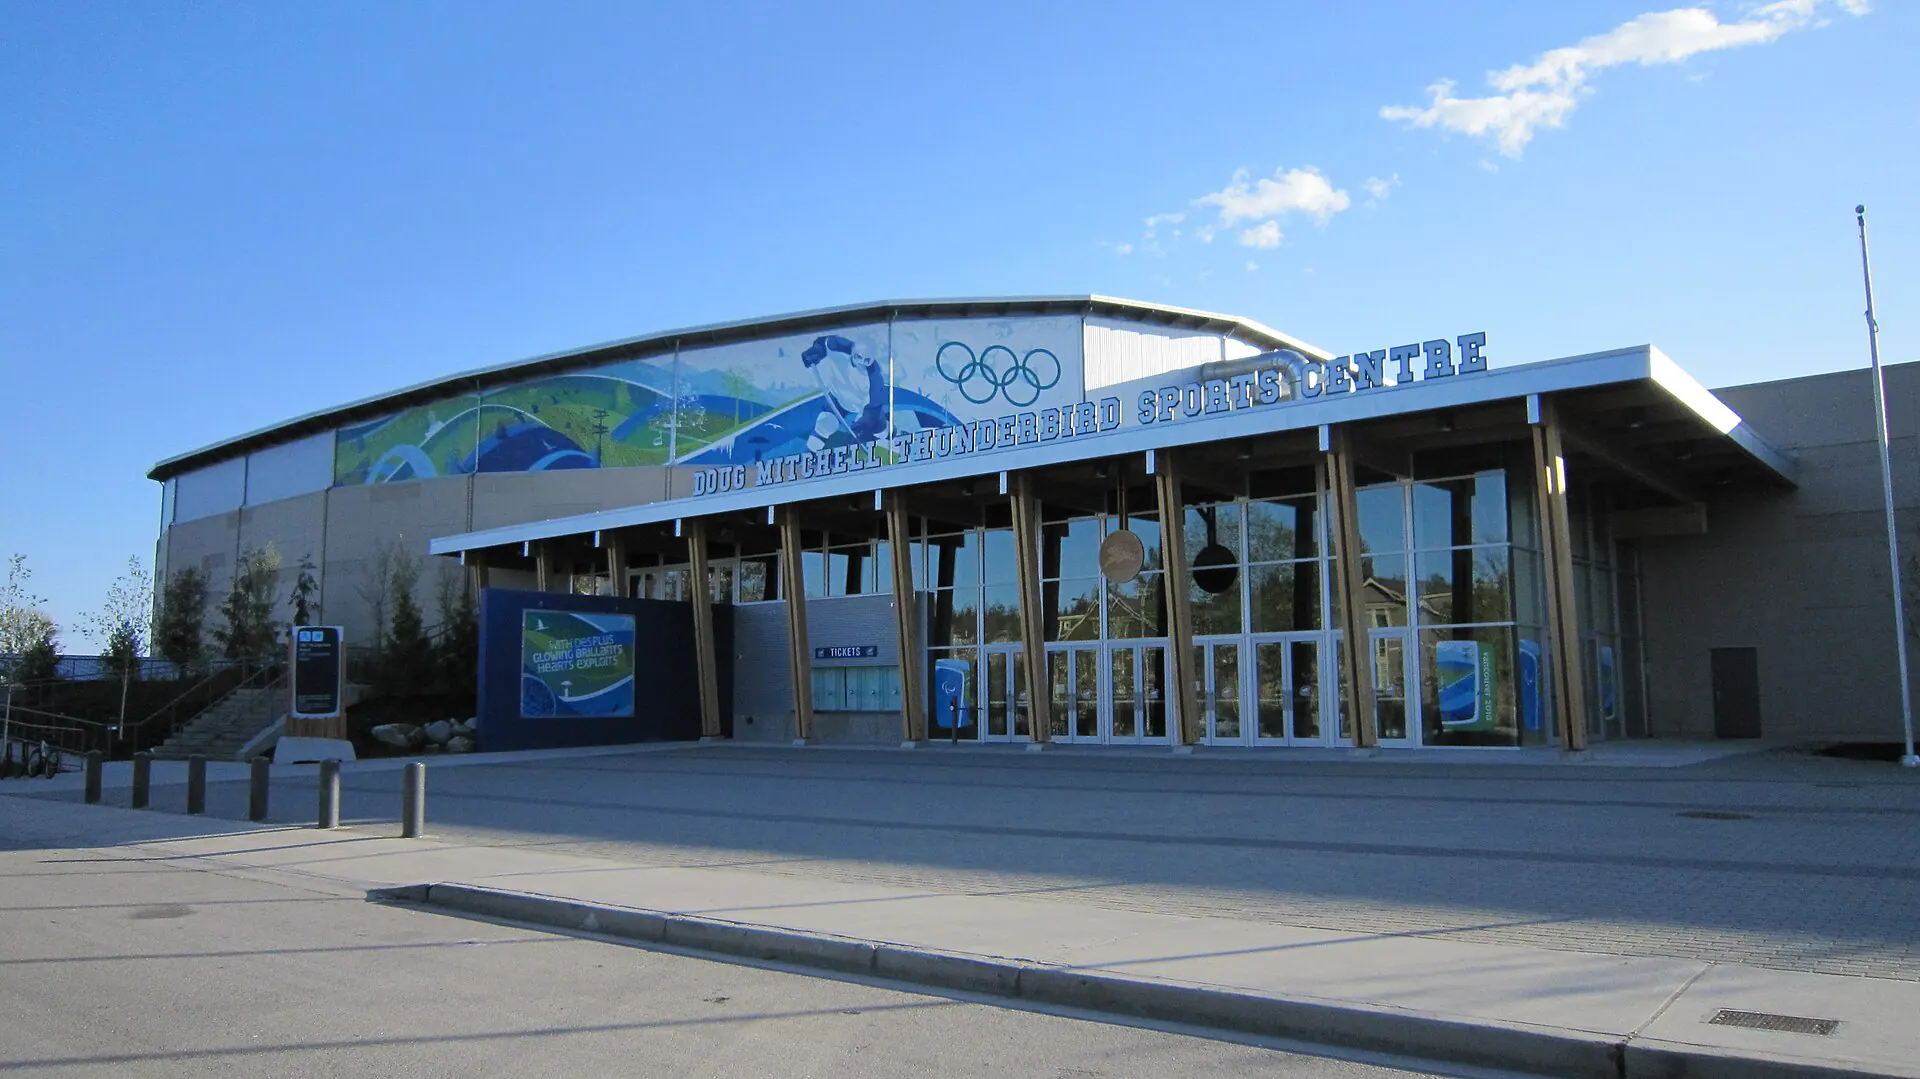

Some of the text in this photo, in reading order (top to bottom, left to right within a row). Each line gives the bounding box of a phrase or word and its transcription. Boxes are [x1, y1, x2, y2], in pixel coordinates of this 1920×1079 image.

[693, 331, 1488, 497] DOUG MITCHELL THUNDERBIRD SPORTS CENTRE
[830, 646, 861, 657] TICKETS
[1484, 699, 1493, 721] 2010
